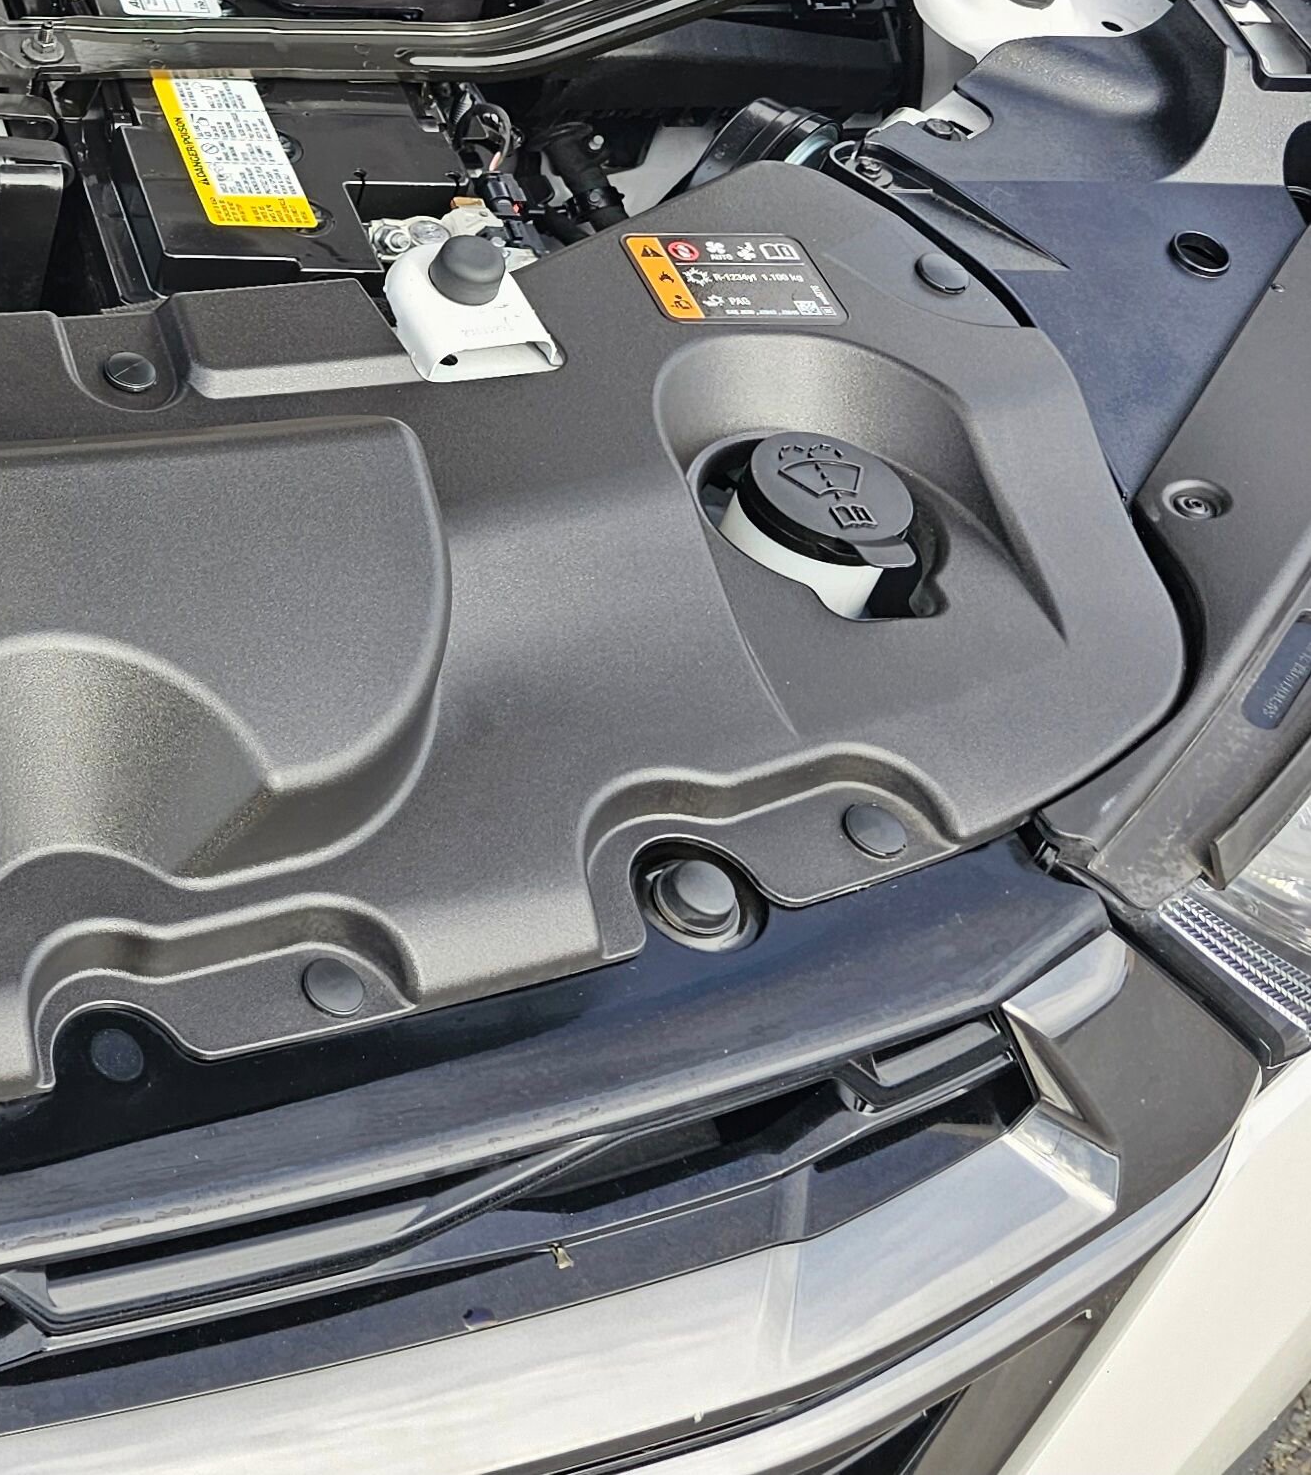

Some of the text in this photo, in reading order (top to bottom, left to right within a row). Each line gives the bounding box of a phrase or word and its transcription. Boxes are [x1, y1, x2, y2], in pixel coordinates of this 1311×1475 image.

[710, 253, 733, 261] AUTO
[791, 274, 804, 283] kg
[729, 297, 751, 306] PAG
